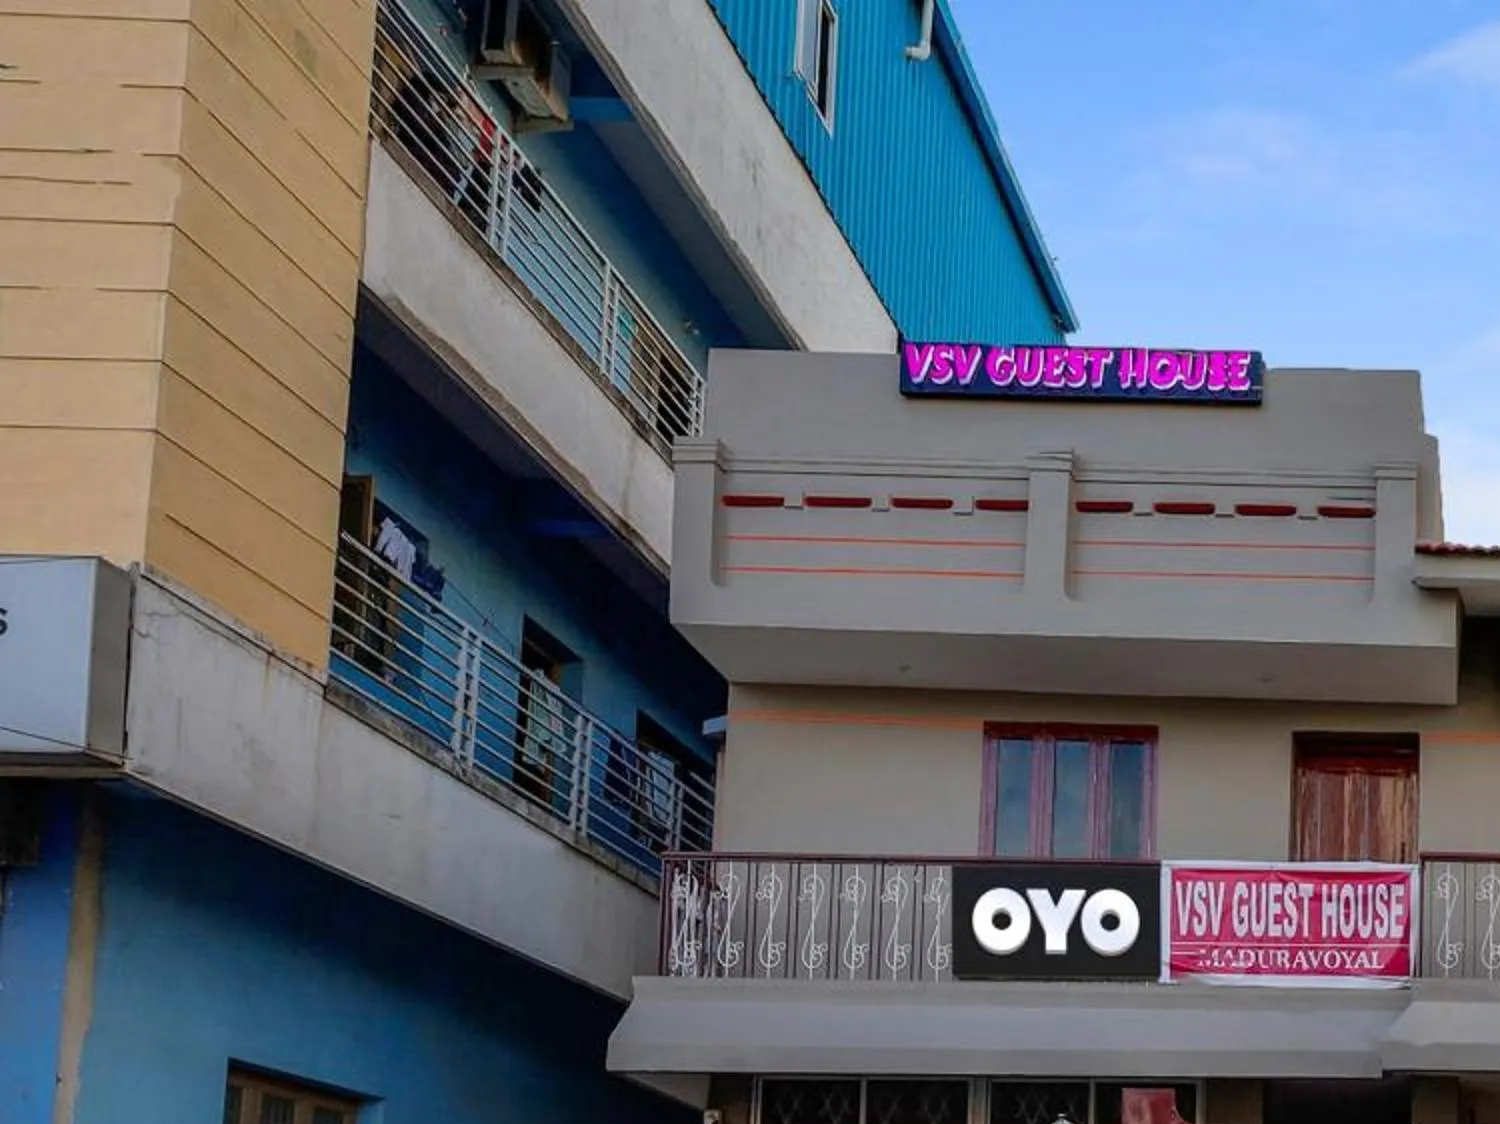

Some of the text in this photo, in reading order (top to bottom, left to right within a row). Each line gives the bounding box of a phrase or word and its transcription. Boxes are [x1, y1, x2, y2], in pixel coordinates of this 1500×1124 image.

[905, 343, 1252, 391] VSV GUEST HOUSE
[971, 887, 1141, 956] OYO
[1175, 880, 1406, 940] VSV GUEST HOUSE
[1198, 948, 1385, 970] MADURAVOYAL
